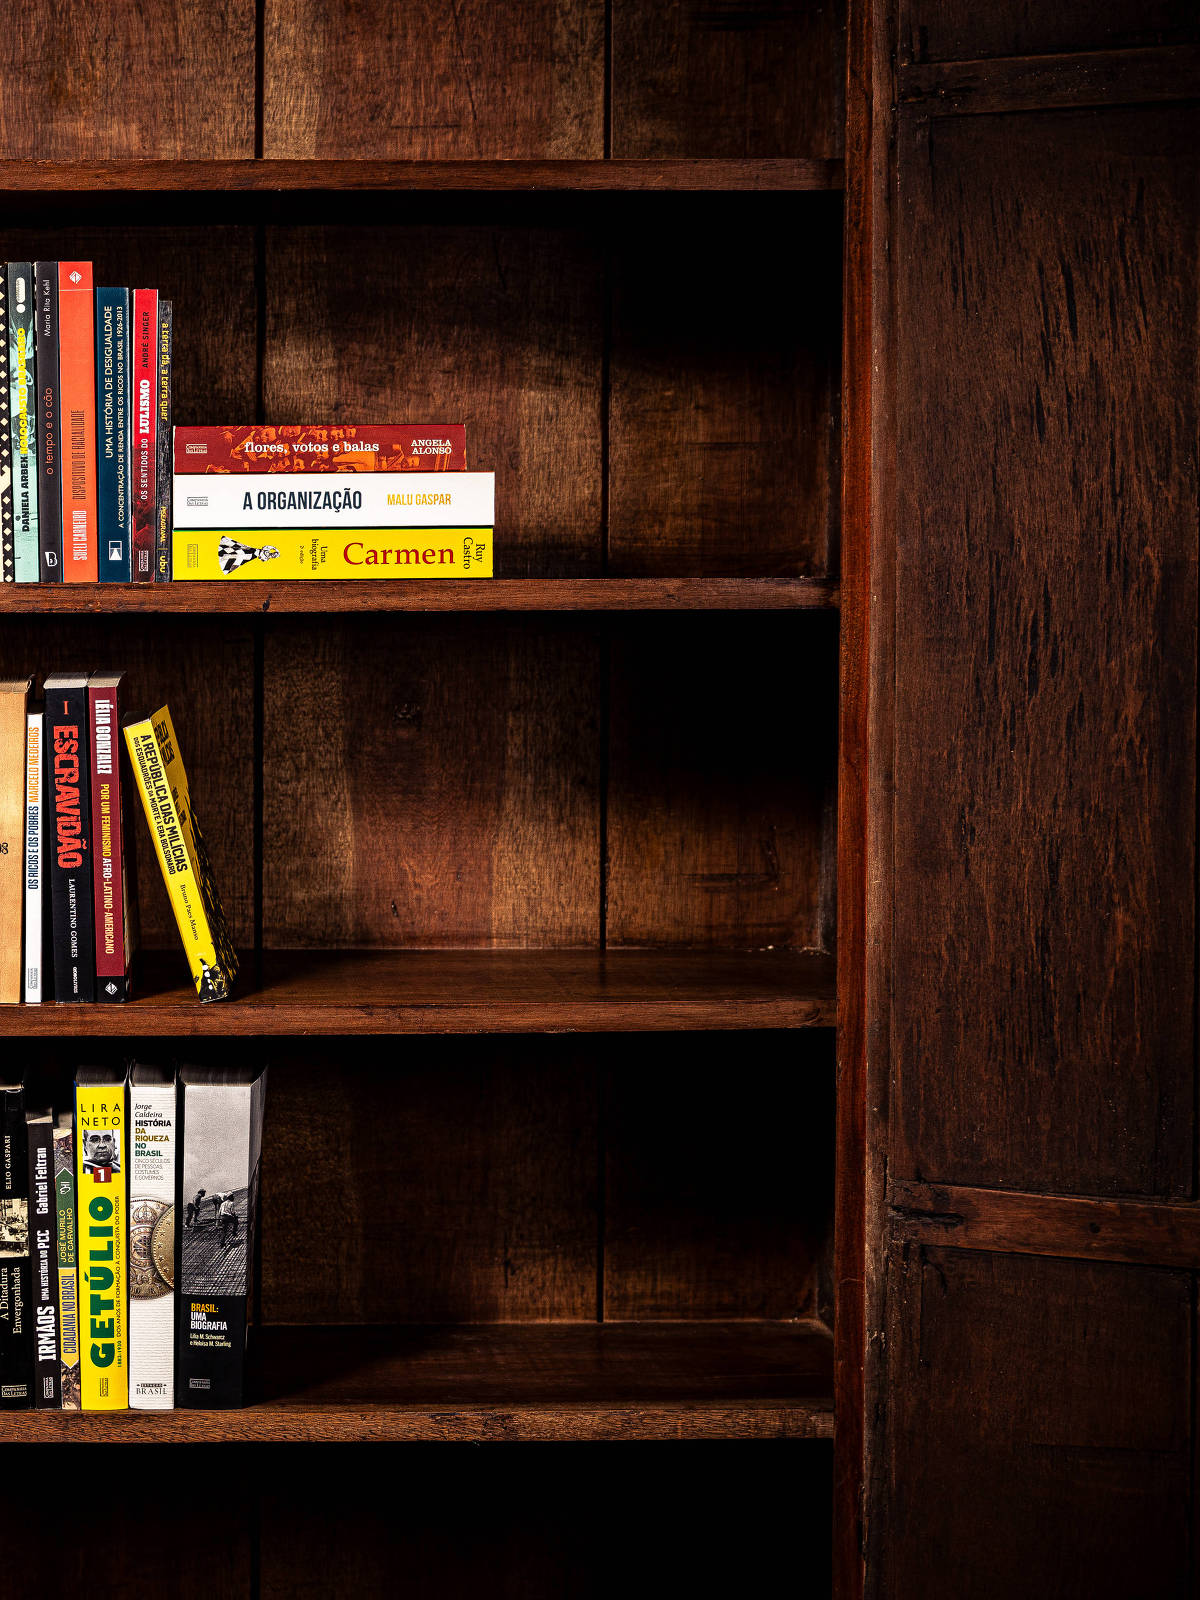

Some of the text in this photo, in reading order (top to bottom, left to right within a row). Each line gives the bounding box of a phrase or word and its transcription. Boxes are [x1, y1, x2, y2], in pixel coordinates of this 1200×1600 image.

[42, 279, 51, 337] Maria Kehl
[141, 312, 150, 369] ANDRÉ SINGER
[17, 328, 29, 455] HOLOCAUSTO BRASILEIRO
[103, 306, 114, 458] UMA HISTÓRIA DE DESIGUALDADE
[160, 330, 170, 421] terra terra quer
[43, 387, 56, 464] tempo cão
[139, 379, 150, 500] OS SENTIDOS DO LULISMO
[244, 440, 380, 454] flores, votos e balas
[410, 439, 452, 448] ANGELA
[411, 447, 452, 455] ALONSO
[71, 410, 87, 500] DISPOSITIVO RACIALIDADE
[19, 456, 30, 532] DANIELA ARBEX
[117, 465, 126, 522] CONCENTRAÇÃO
[242, 487, 362, 513] A ORGANIZAÇÃO
[387, 493, 452, 506] MALU GASPAR
[72, 510, 88, 561] SUELI CARNEIRO
[309, 539, 320, 571] biografia
[343, 542, 456, 566] Carmen
[463, 537, 474, 570] Castro
[473, 544, 486, 563] Ruy
[159, 555, 168, 573] ubu
[28, 727, 40, 803] MARCELO MEDEIROS
[95, 699, 114, 775] LÉLIA GONZALEZ
[140, 734, 152, 743] A
[53, 725, 88, 869] ESCRAVIDÃO
[143, 743, 169, 799] REPÚBLICA
[136, 747, 176, 875] ESQUADRÕES MORTE BOLSONARO
[160, 799, 175, 825] DAS
[28, 806, 39, 890] OS RICOS OS POBRES
[100, 783, 115, 954] POR UM FEMINISMO AFRO-LATINO-AMERICANO
[166, 823, 188, 873] MILÍCIAS
[68, 878, 78, 958] LAURENTINO GOMES
[179, 884, 199, 941] Bruno Manso
[80, 1103, 121, 1113] LIRA
[81, 1116, 121, 1127] NETO
[134, 1103, 152, 1111] Jorge
[135, 1118, 172, 1127] HISTÓRIA
[4, 1135, 12, 1169] GASPARI
[97, 1168, 105, 1182] 1
[34, 1147, 49, 1215] Gabriel Feltran
[58, 1209, 67, 1263] JOSÉ MURILO
[66, 1207, 75, 1263] DE CARVALHO
[36, 1229, 50, 1301] UMA HISTÓRIA PCC
[84, 1196, 115, 1369] GETÚLIO
[0, 1312, 9, 1321] A
[11, 1266, 24, 1334] Envergonhada
[60, 1273, 77, 1354] CIDADANIA NO BRASIL
[190, 1303, 219, 1313] BRASIL:
[190, 1312, 207, 1321] UMA
[190, 1321, 228, 1331] BIOGRAFIA
[36, 1306, 57, 1362] IRMÃOS
